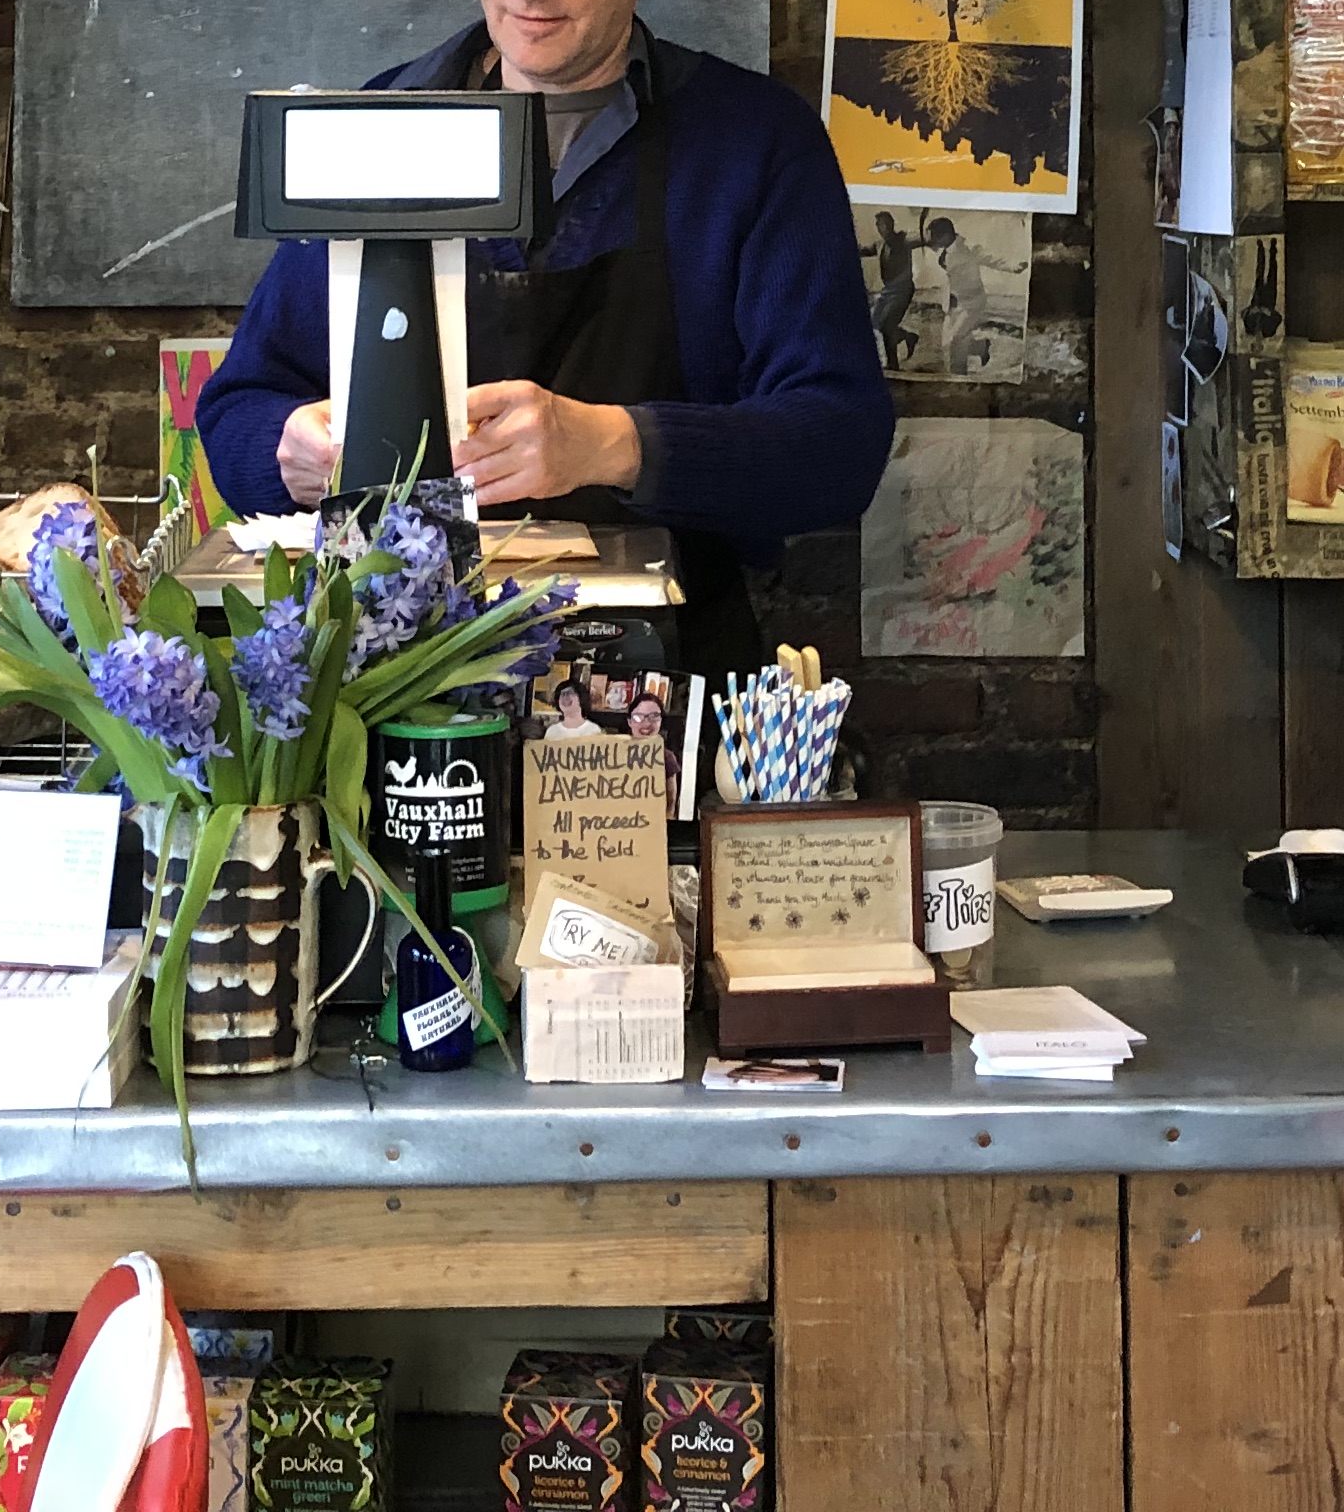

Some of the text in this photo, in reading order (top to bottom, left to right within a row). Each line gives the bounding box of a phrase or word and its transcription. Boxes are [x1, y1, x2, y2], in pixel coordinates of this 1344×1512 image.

[588, 624, 616, 636] Berkel
[385, 797, 484, 821] Vauxhall
[384, 819, 485, 845] City Farm
[553, 810, 650, 841] All proceeds
[530, 839, 588, 860] to the
[563, 915, 591, 947] TRY
[1035, 1040, 1088, 1048] ITALO
[671, 1431, 735, 1454] pukka
[281, 1455, 343, 1476] pukka
[529, 1452, 592, 1474] pukka
[676, 1456, 716, 1469] licorice
[533, 1475, 573, 1488] licorice
[673, 1469, 731, 1482] cinnamon
[270, 1477, 354, 1493] mint matcha
[530, 1488, 589, 1500] cinnamon
[293, 1491, 331, 1505] green
